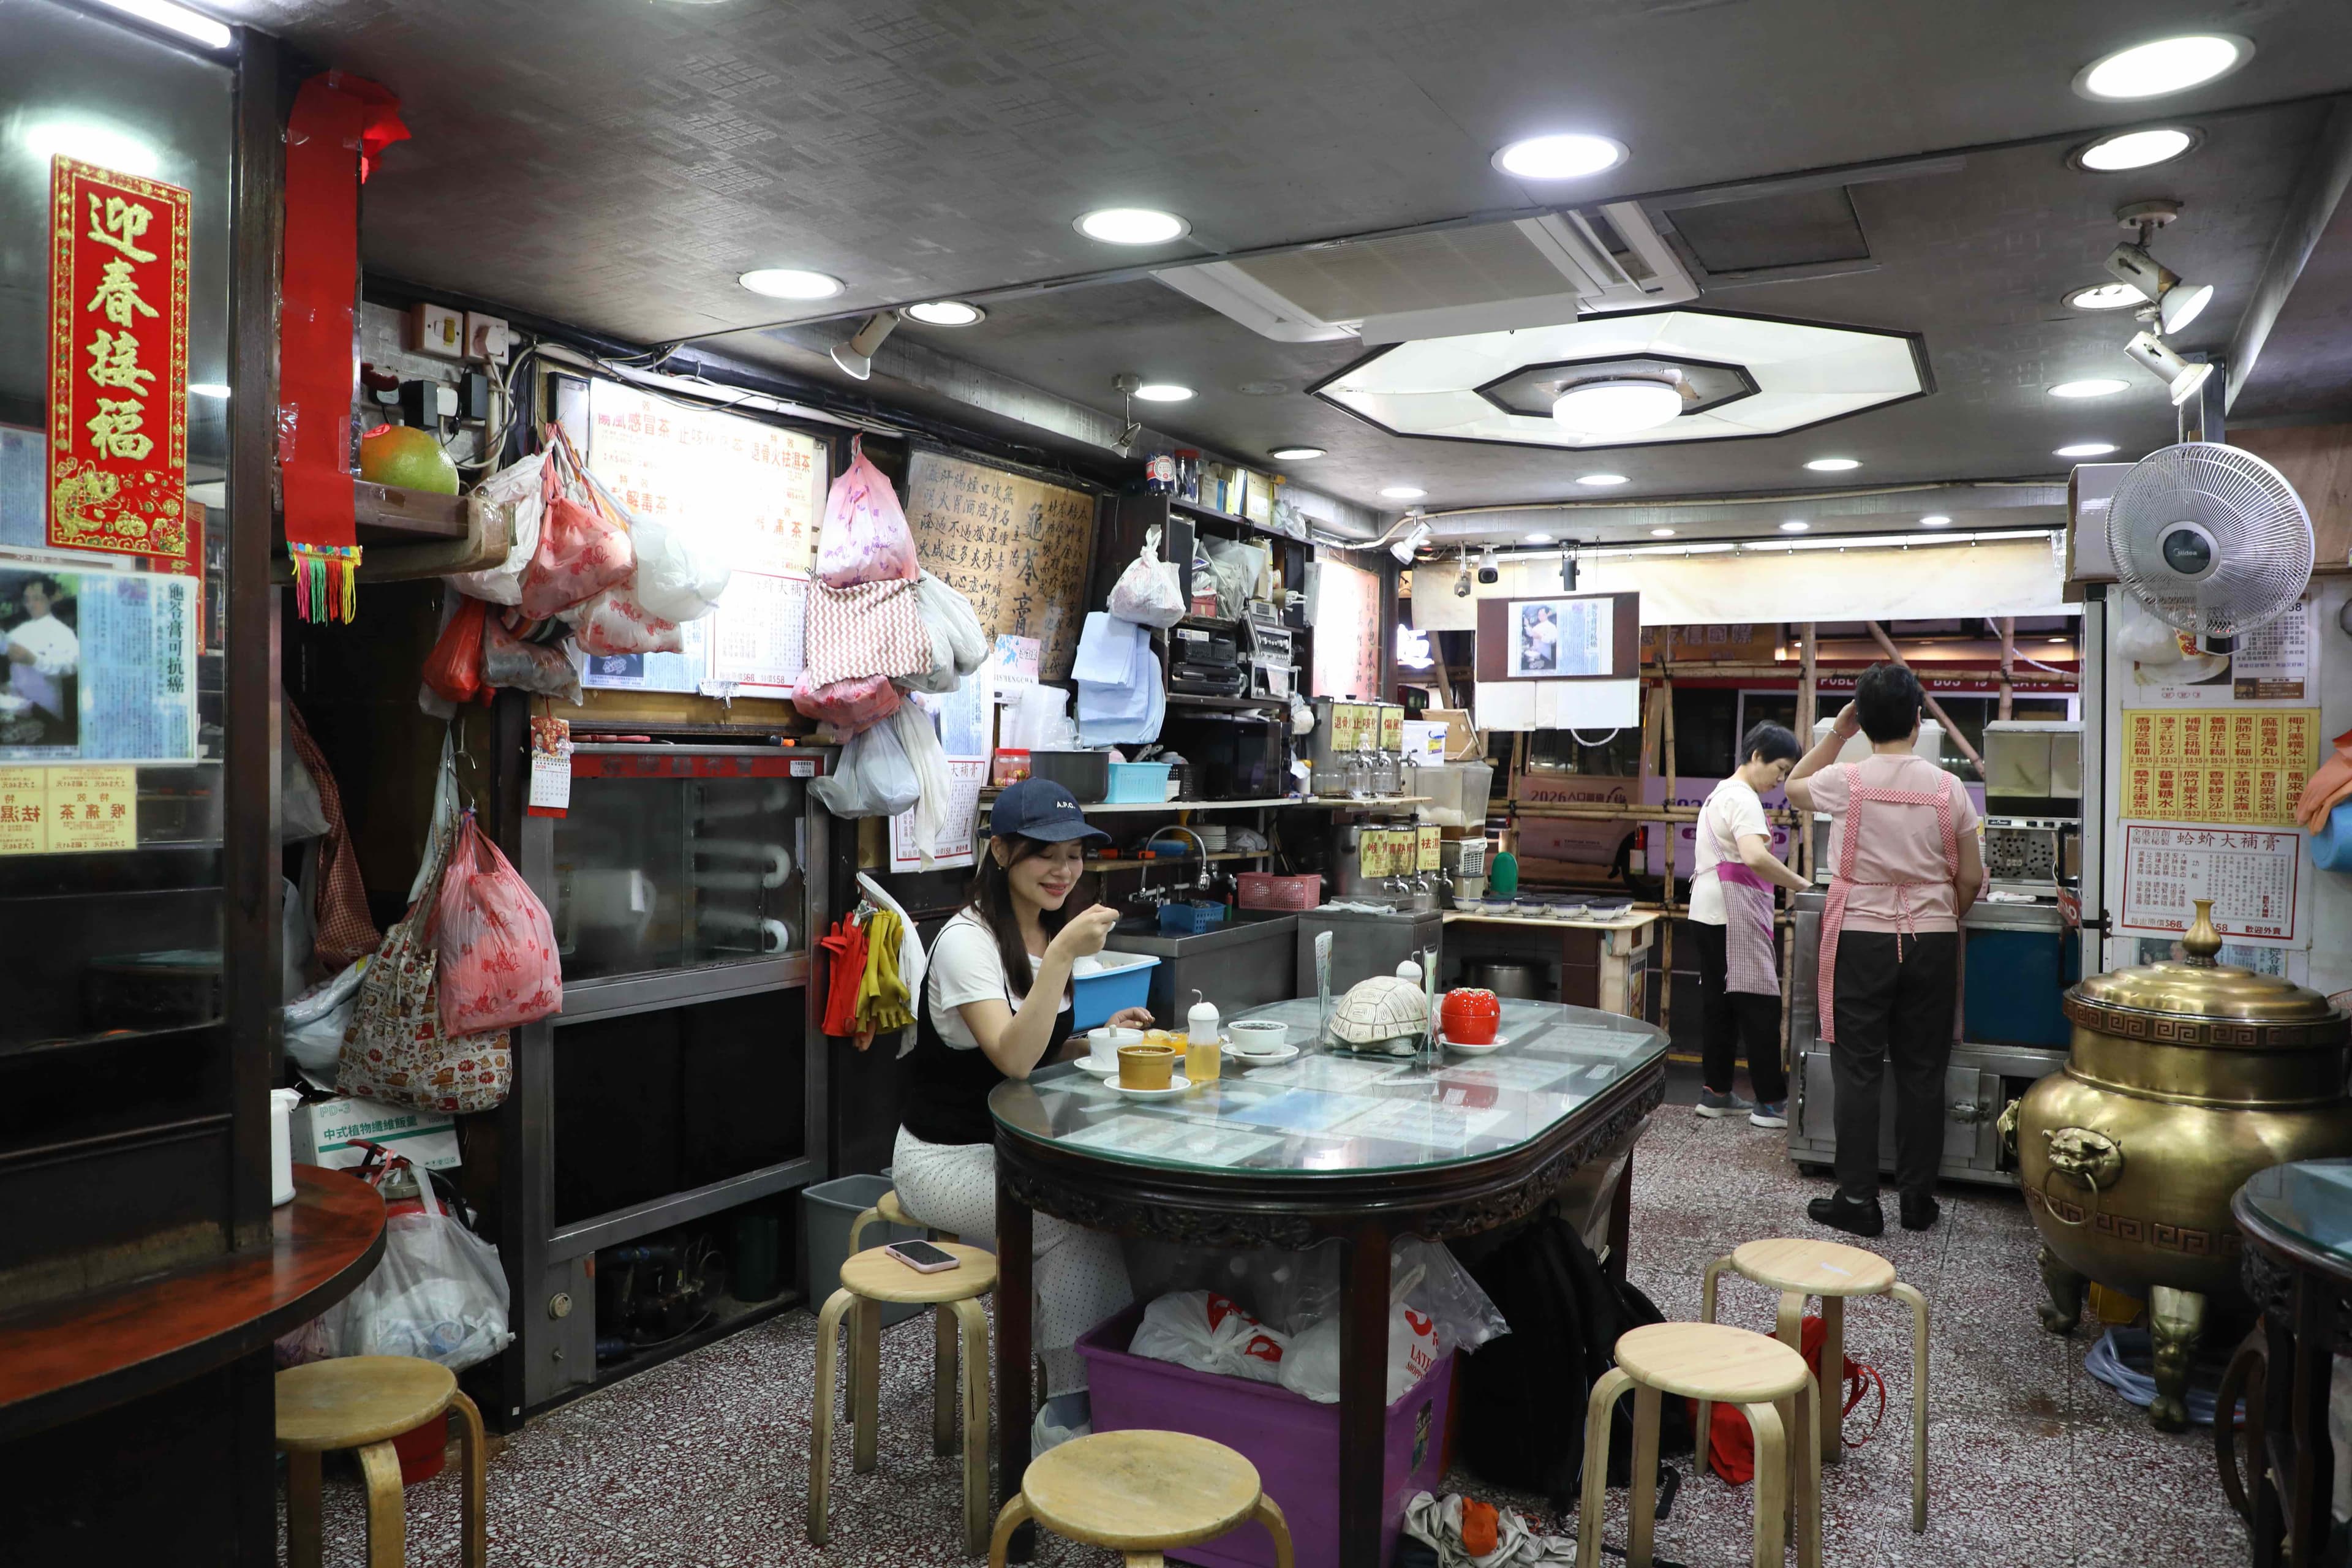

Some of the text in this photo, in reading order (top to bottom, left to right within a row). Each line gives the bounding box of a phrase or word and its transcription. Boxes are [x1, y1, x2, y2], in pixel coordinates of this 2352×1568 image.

[86, 191, 159, 462] 迎春接福
[2176, 832, 2280, 852] 蛤蚧大補膏
[320, 1103, 351, 1118] PD-3
